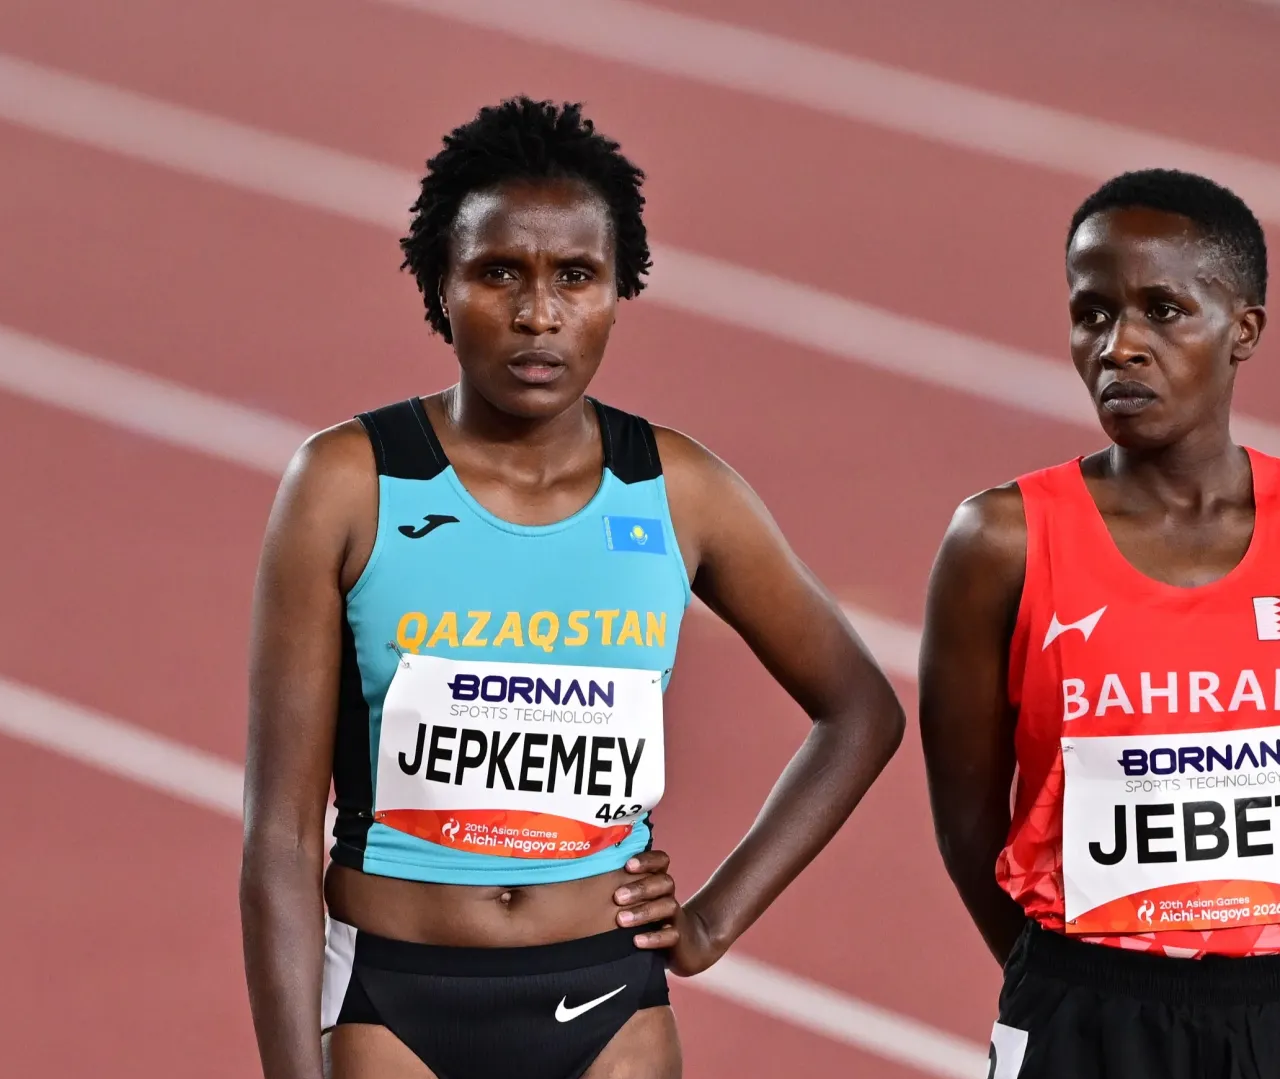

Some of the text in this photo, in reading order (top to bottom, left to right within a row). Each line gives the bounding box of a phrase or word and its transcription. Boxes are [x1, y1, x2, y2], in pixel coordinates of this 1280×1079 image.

[396, 608, 667, 654] QAZAQSTAN
[447, 673, 615, 708] BORNAN
[450, 704, 614, 725] SPORTS TECHNOLOGY
[398, 723, 646, 798] JEPKEMEY
[1125, 778, 1181, 793] SPORTS
[465, 822, 558, 840] 20th Asian Games
[463, 832, 591, 853] Aichi-Nagoya 2026
[1159, 895, 1250, 909] 20th Asian Games
[1160, 906, 1250, 924] Aichi-Nagoya
